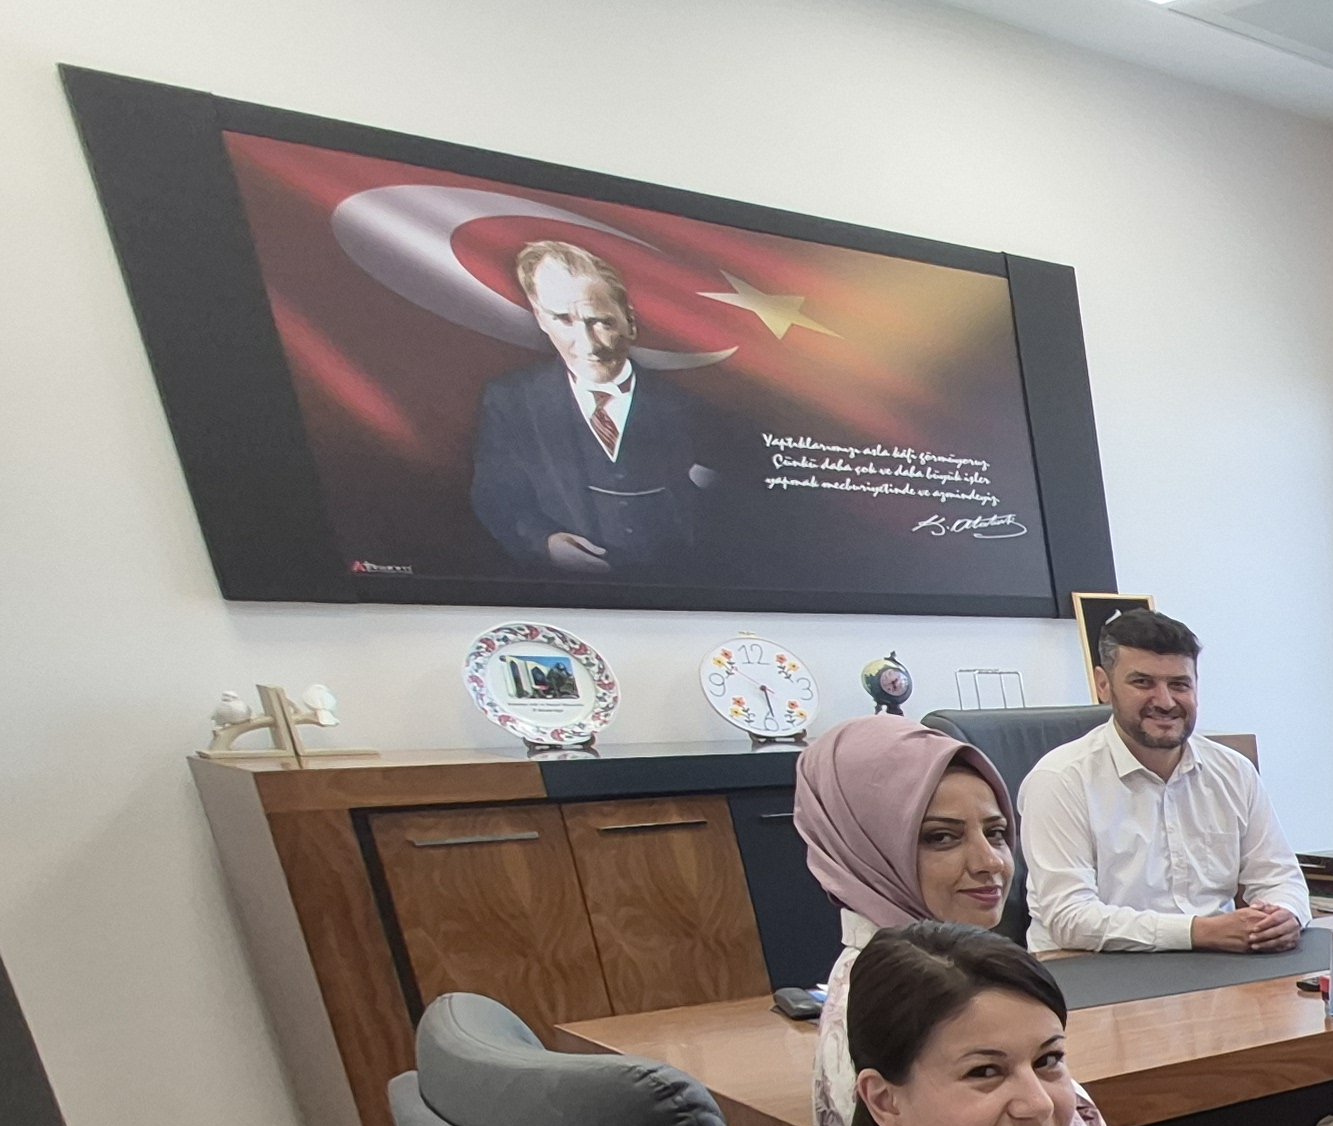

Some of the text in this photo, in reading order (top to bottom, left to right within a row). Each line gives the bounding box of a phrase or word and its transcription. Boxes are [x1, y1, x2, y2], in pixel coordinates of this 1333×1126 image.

[863, 444, 890, 456] asla
[773, 454, 991, 485] Çünkü daha çok ve daha büyük işler
[765, 475, 820, 490] yapmak
[918, 489, 931, 497] ve
[738, 643, 772, 666] 12
[708, 672, 727, 698] 9
[796, 677, 814, 701] 3
[763, 710, 780, 732] 6
